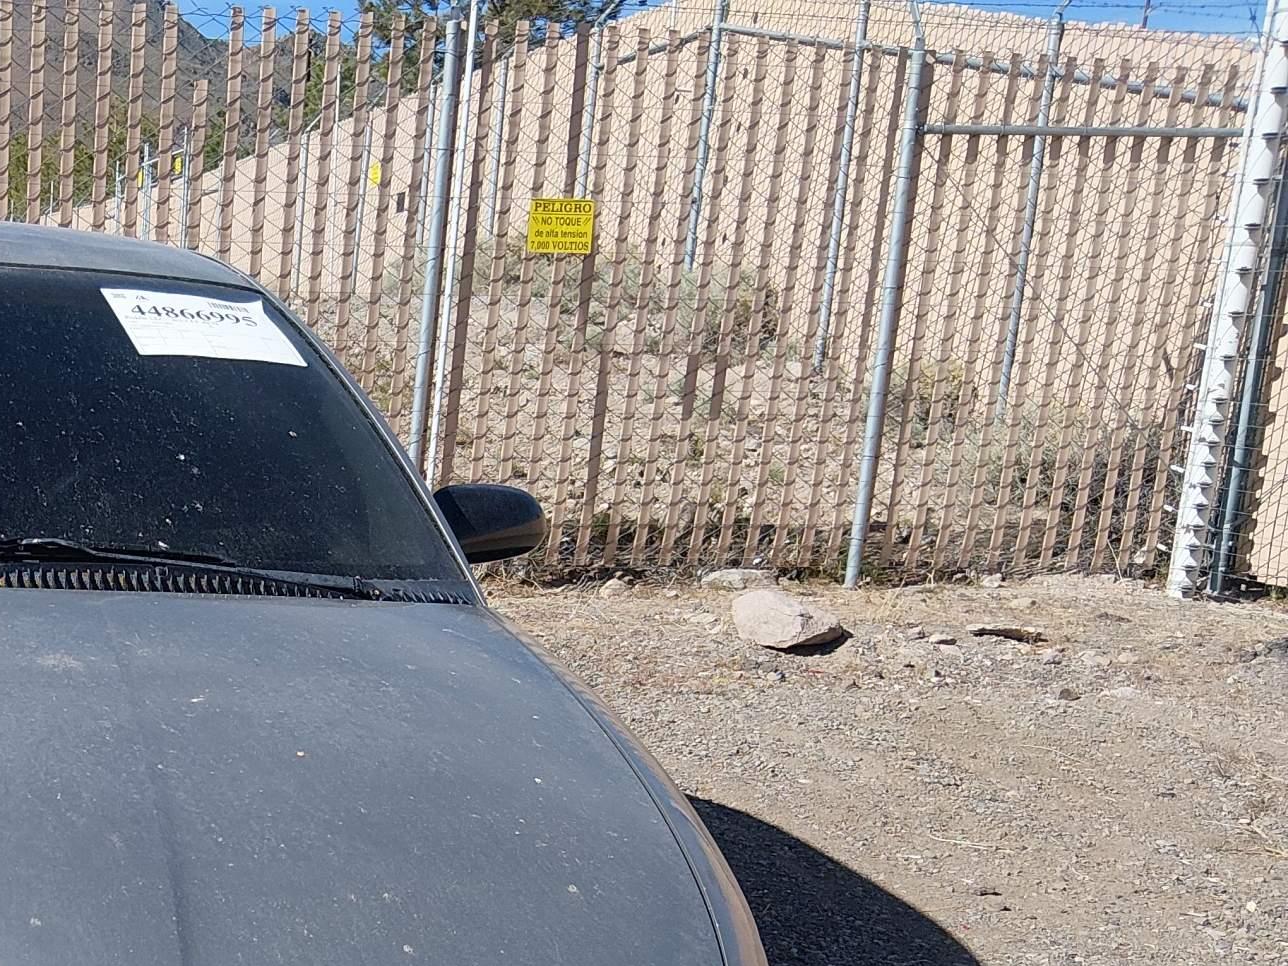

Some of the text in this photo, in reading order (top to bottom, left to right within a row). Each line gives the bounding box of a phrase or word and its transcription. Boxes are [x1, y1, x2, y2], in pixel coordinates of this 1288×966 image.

[534, 202, 592, 213] PELIGRO
[541, 216, 582, 226] NO TOQUE
[534, 229, 545, 238] de
[530, 240, 590, 251] 7,000 VOLTIOS
[131, 304, 258, 328] 44866995
